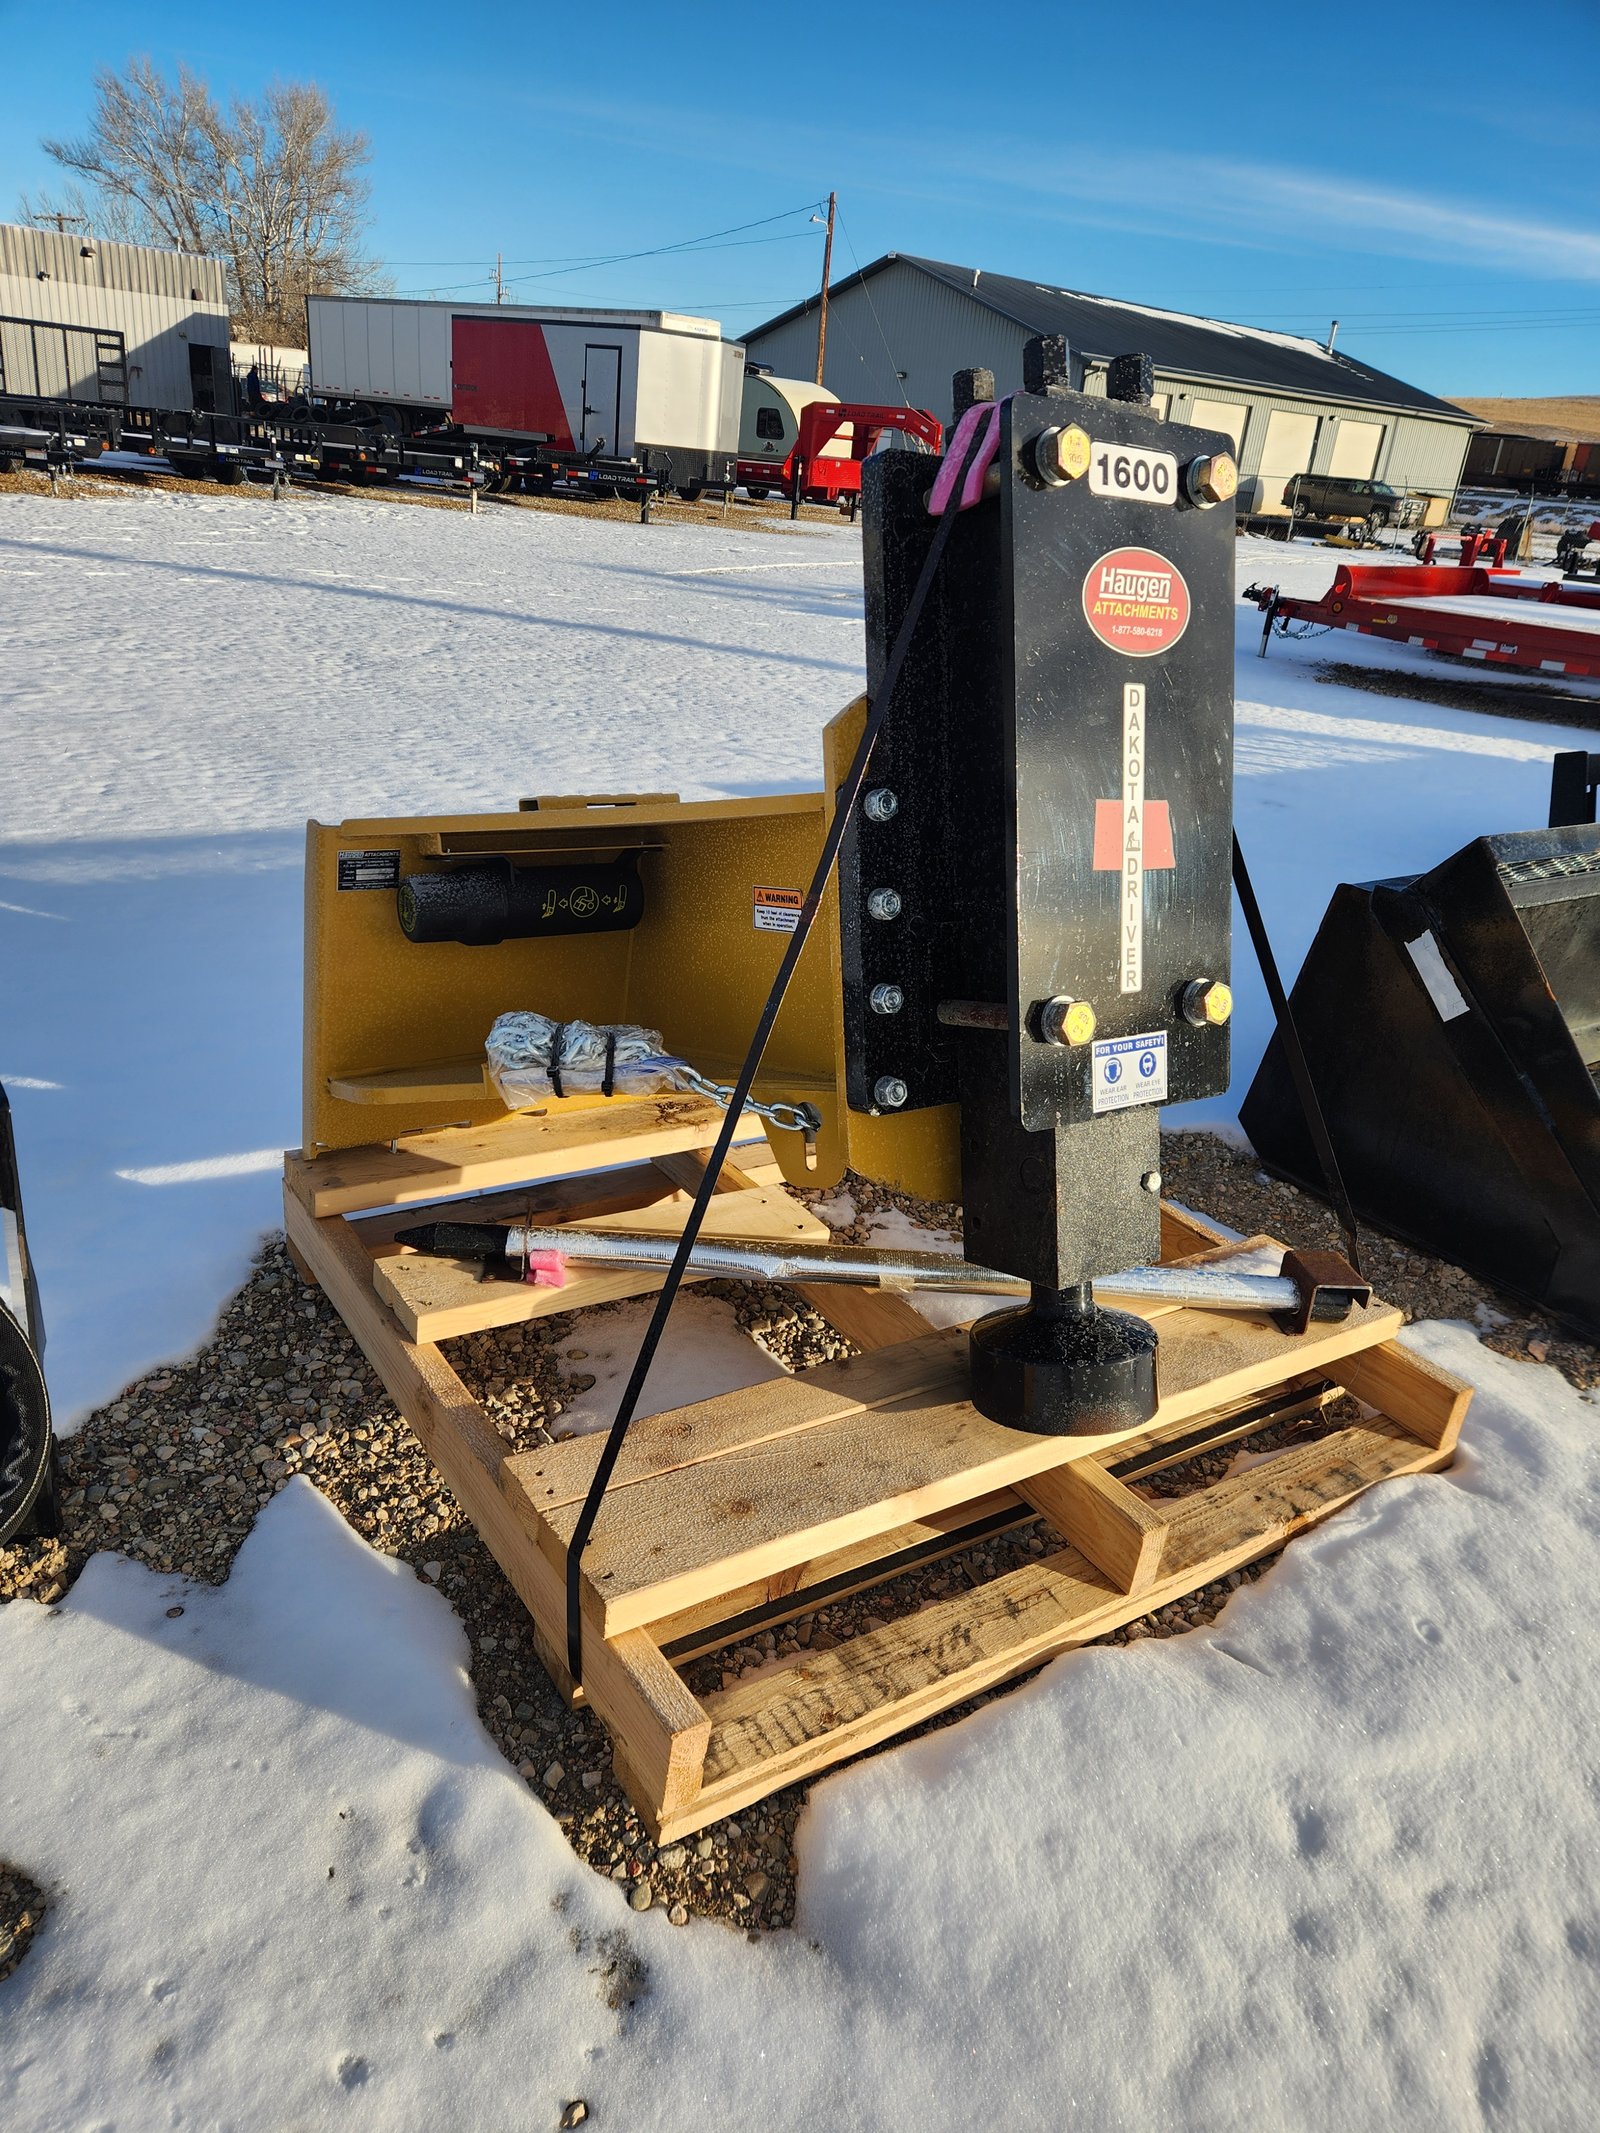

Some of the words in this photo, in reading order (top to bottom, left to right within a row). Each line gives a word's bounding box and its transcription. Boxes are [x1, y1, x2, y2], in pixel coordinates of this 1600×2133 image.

[1097, 453, 1169, 495] 1600
[1100, 567, 1171, 602] Haugen
[1093, 601, 1179, 621] ATTACHMENTS
[1112, 625, 1163, 637] 1-877-580-6218
[1127, 688, 1141, 824] DAKOTA
[765, 893, 799, 905] WARNING
[1125, 857, 1139, 988] DRIVER
[1095, 1046, 1111, 1056] FOR
[1112, 1042, 1133, 1052] YOUR
[1135, 1037, 1164, 1048] SAFETY!
[1100, 1086, 1115, 1096] WEAR
[1116, 1085, 1127, 1093] EAR
[1136, 1080, 1150, 1089] WEAR
[1151, 1079, 1161, 1087] EYE
[1097, 1093, 1129, 1105] PROTECTION
[1133, 1087, 1163, 1099] PROTECTION
